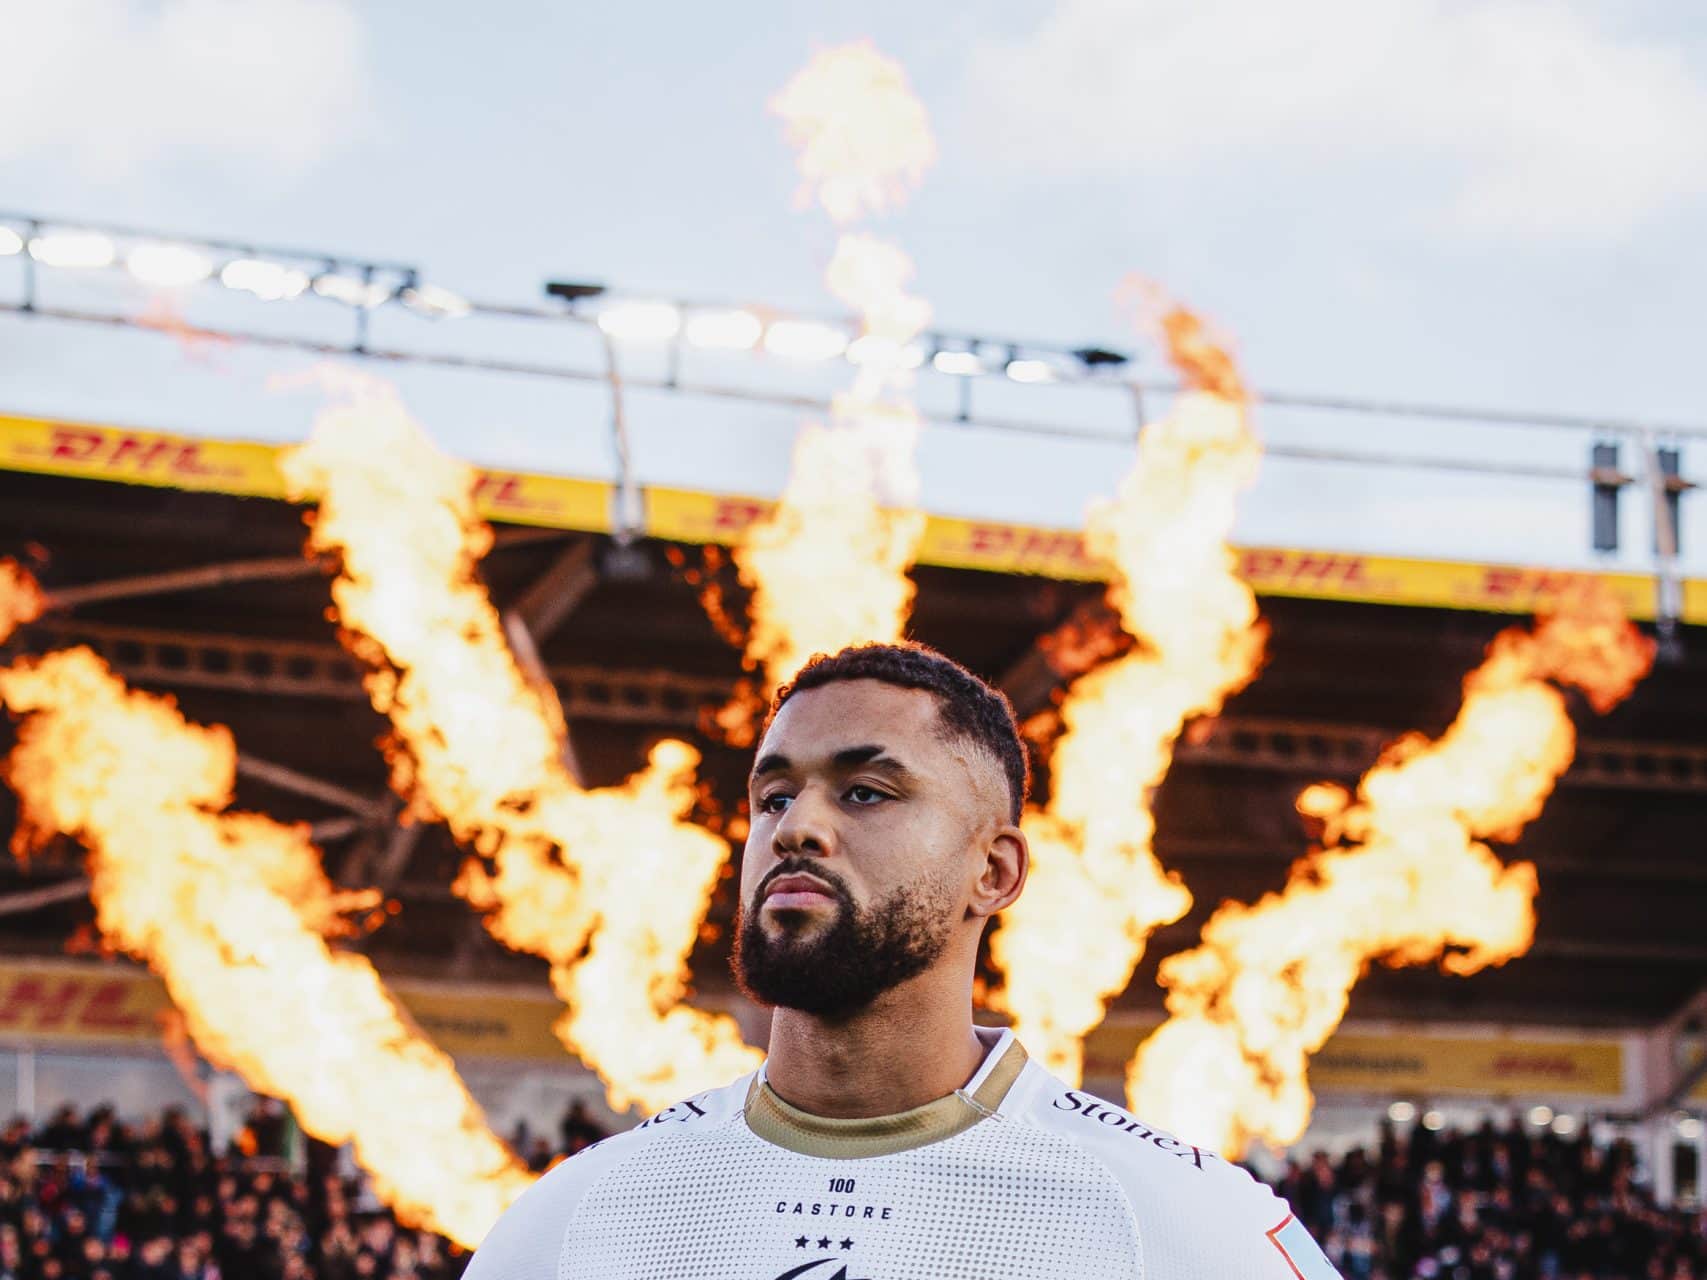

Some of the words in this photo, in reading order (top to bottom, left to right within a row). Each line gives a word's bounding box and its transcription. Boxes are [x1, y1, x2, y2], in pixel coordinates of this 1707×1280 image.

[50, 424, 212, 476] DHL
[1052, 1091, 1218, 1171] StoneX
[828, 1178, 856, 1194] 100
[775, 1201, 893, 1220] CASTORE
